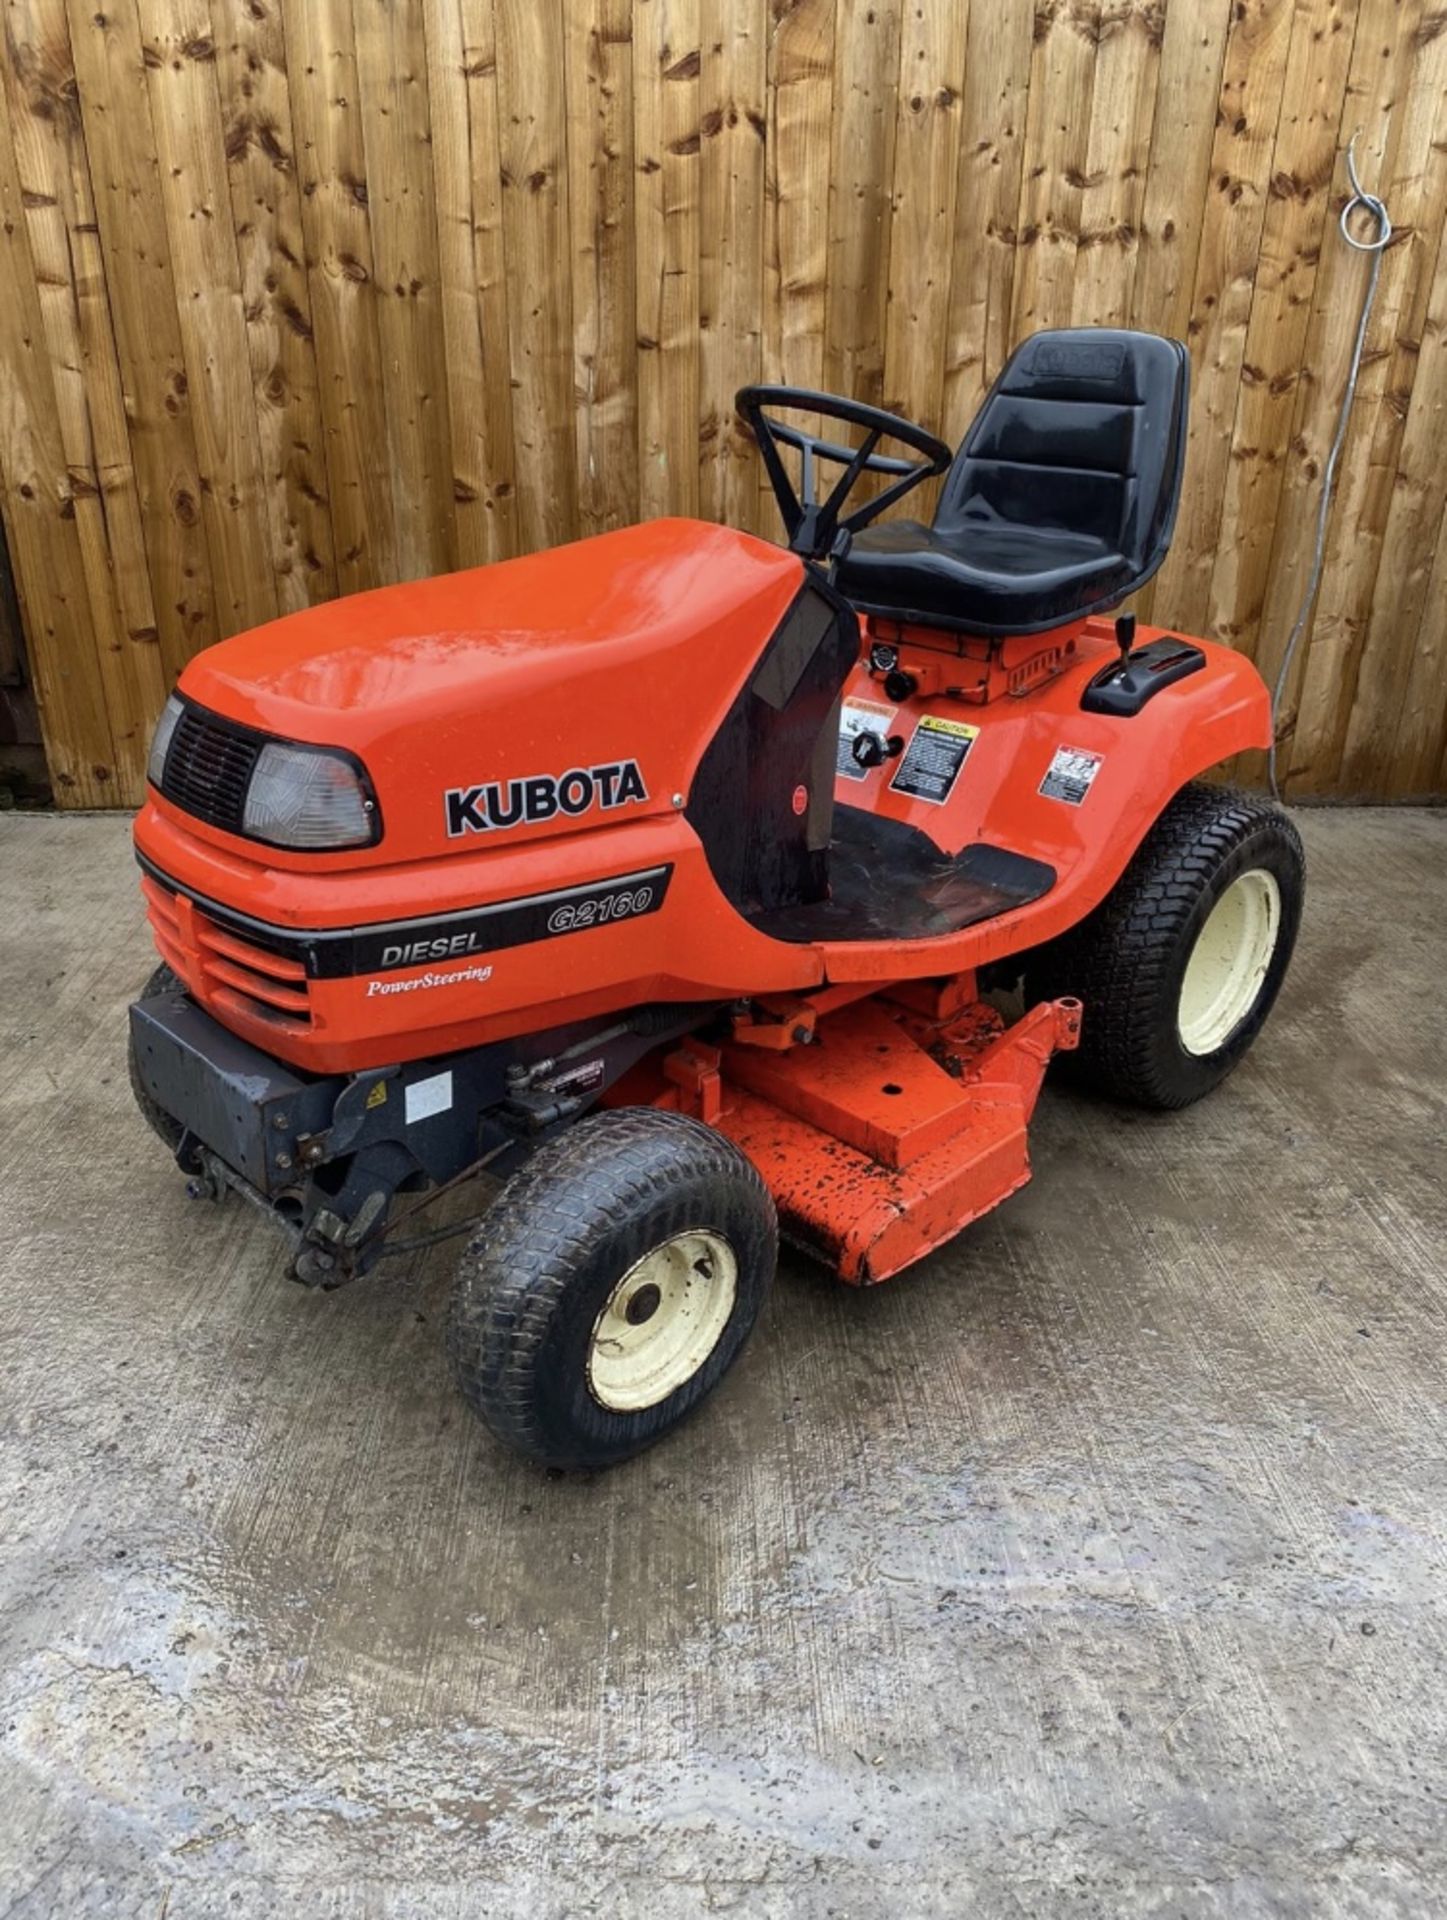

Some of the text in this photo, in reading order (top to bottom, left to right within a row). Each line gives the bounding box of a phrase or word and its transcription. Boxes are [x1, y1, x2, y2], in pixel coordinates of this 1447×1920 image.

[446, 759, 648, 836] KUBOTA
[548, 887, 653, 933] G2160
[381, 932, 483, 967] DIESEL
